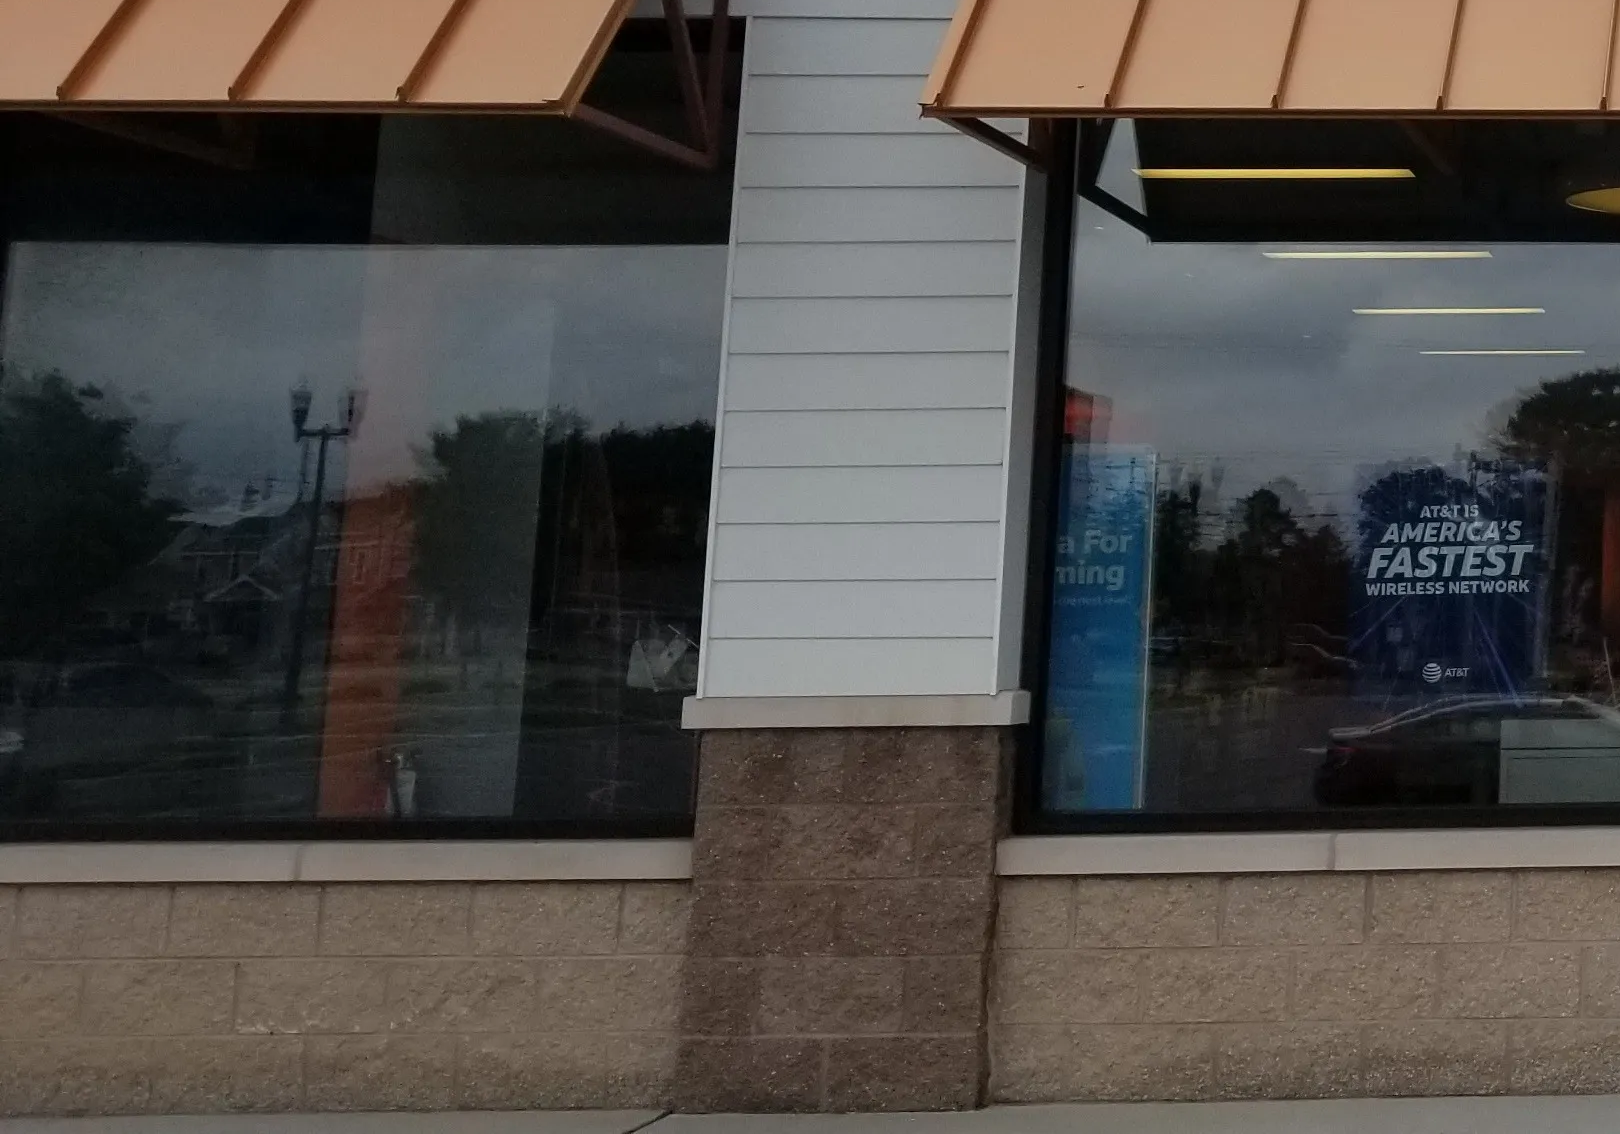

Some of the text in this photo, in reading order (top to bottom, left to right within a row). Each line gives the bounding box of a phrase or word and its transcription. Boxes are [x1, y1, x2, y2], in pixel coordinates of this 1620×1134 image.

[1419, 504, 1479, 518] AT&T IS
[1083, 528, 1134, 555] For
[1380, 520, 1523, 543] AMERICA'S
[1366, 544, 1534, 579] FASTEST
[1365, 579, 1530, 596] WIRELESS NETWORK
[1444, 667, 1470, 677] AT&T
